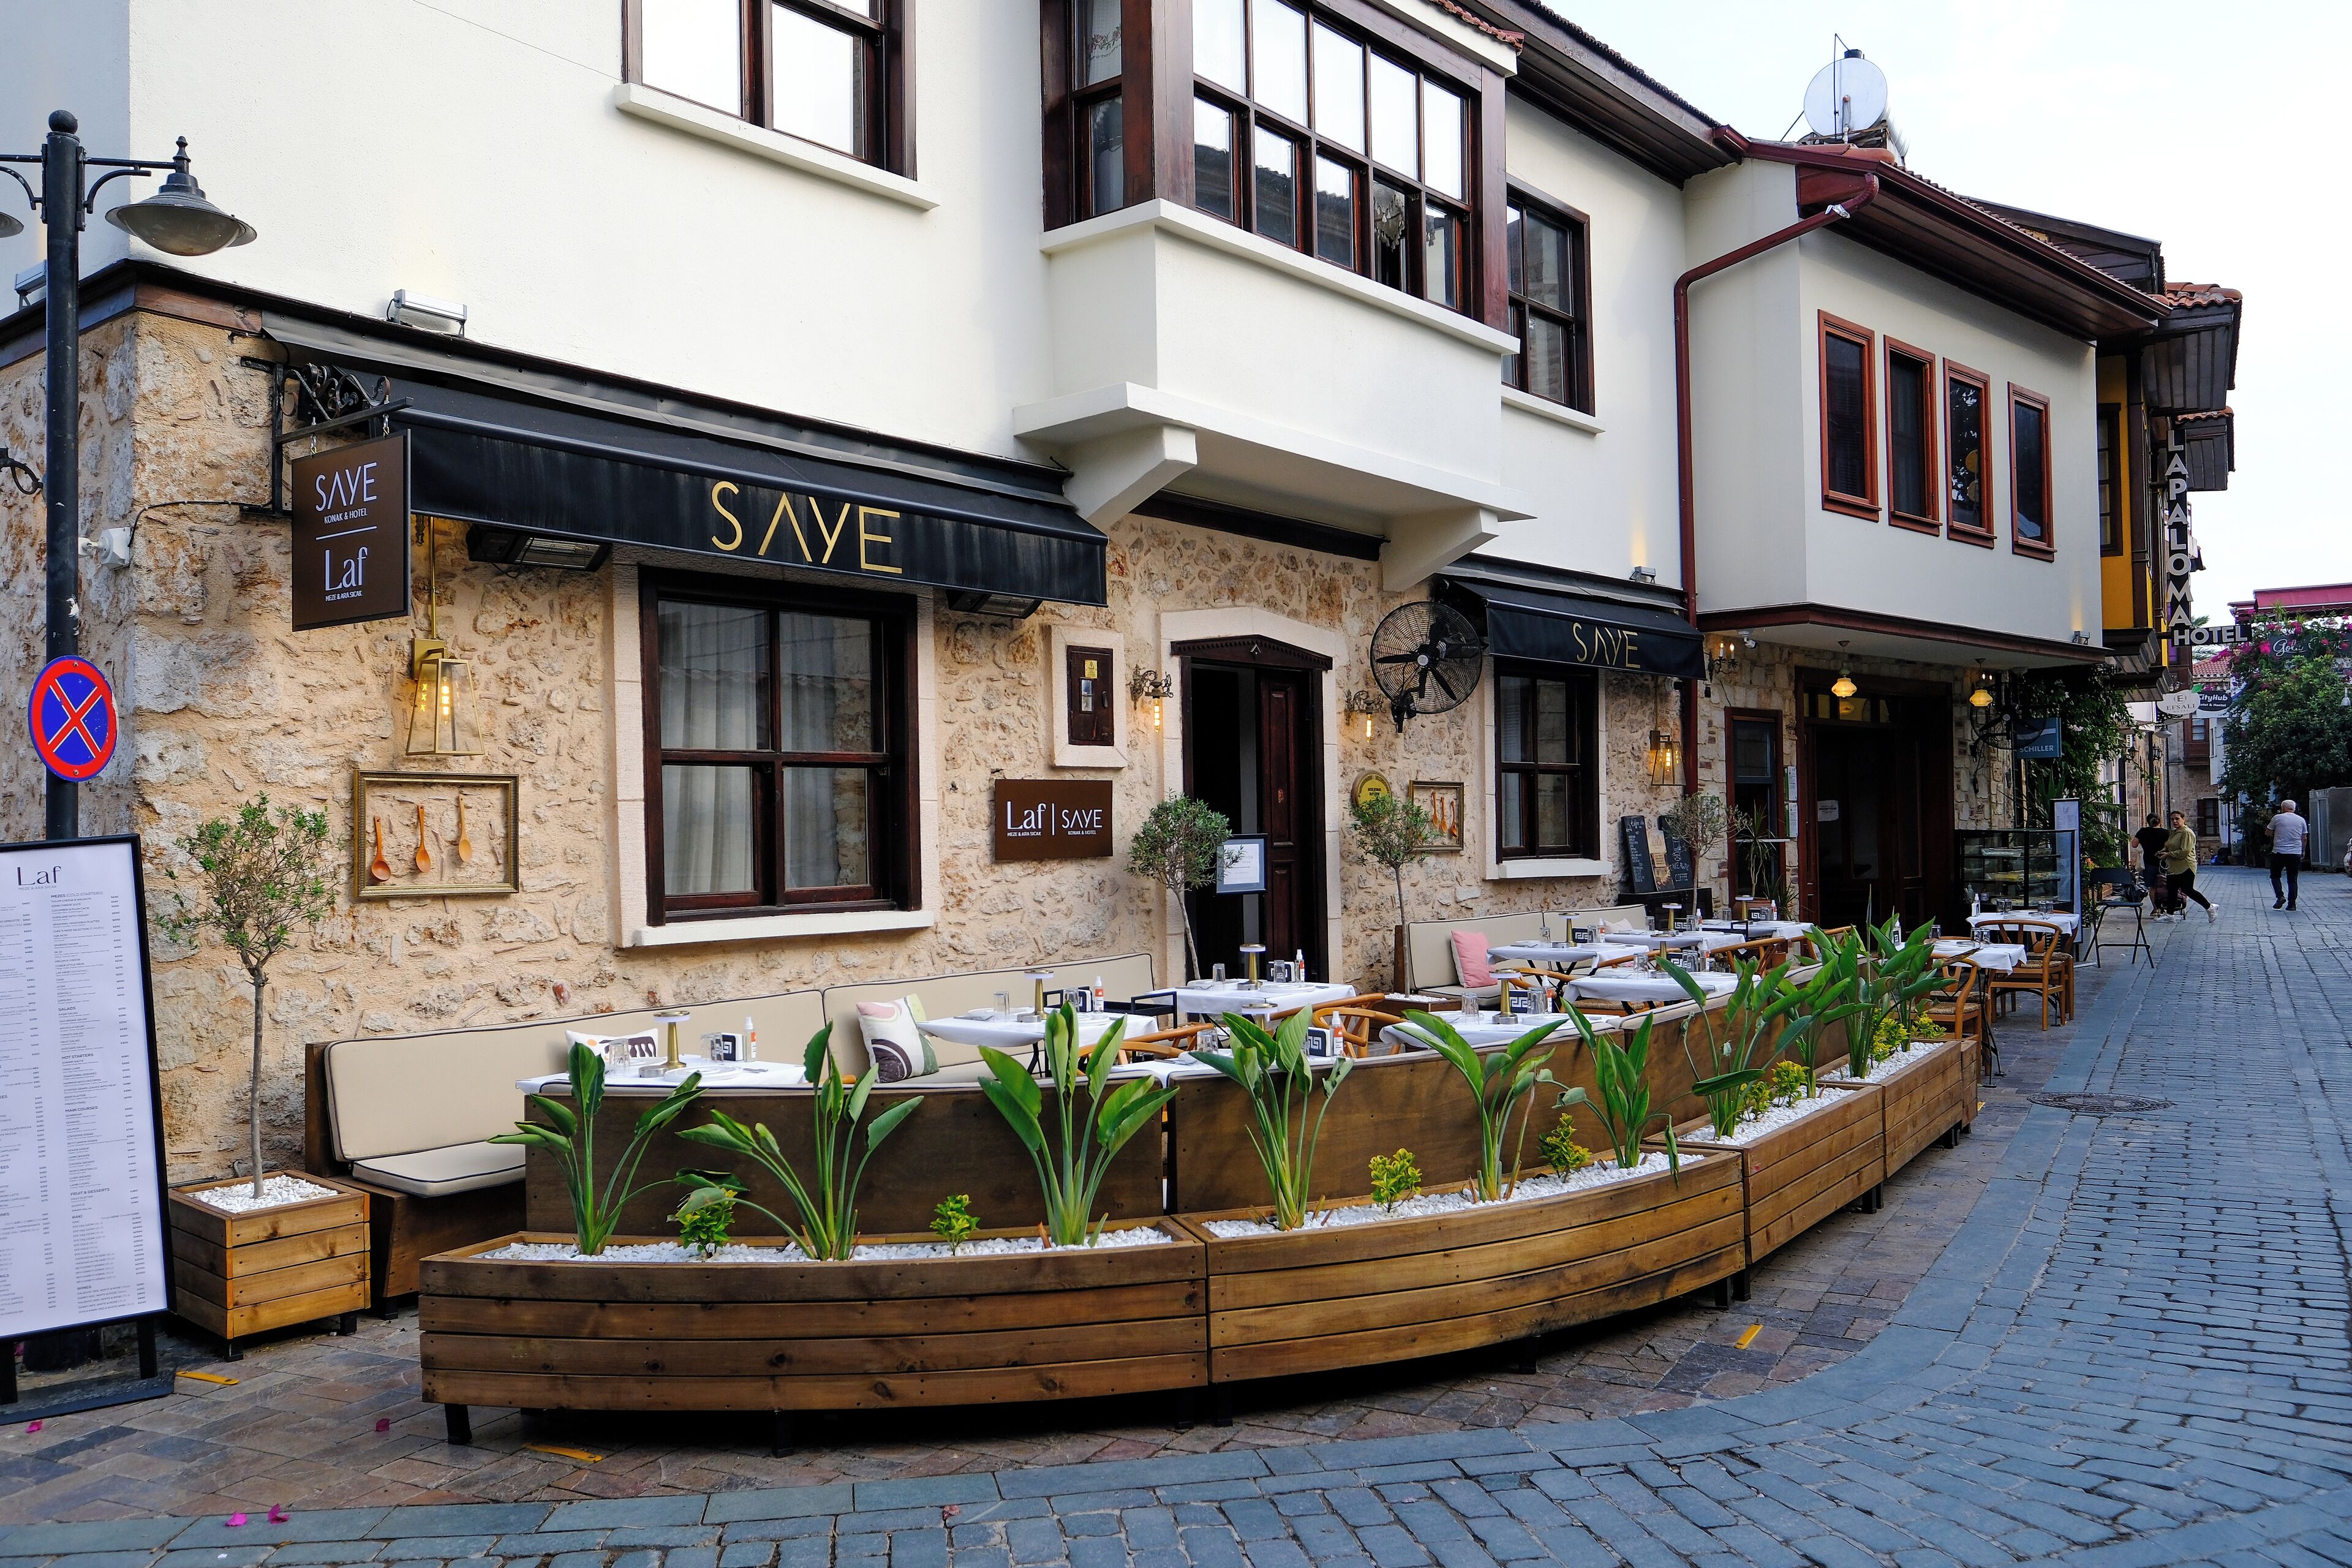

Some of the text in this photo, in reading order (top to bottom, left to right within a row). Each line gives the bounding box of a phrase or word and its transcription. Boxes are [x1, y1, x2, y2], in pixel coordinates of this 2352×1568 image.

[315, 462, 377, 511] SAYE
[324, 513, 343, 524] KONAK
[349, 508, 368, 519] HOTEL
[711, 480, 903, 575] SAYE
[325, 547, 368, 591] Laf
[1573, 622, 1641, 668] SAYE
[2174, 626, 2248, 646] HOTEL
[1007, 801, 1046, 829] Laf
[1061, 809, 1102, 828] SAYE
[17, 866, 61, 886] Laf
